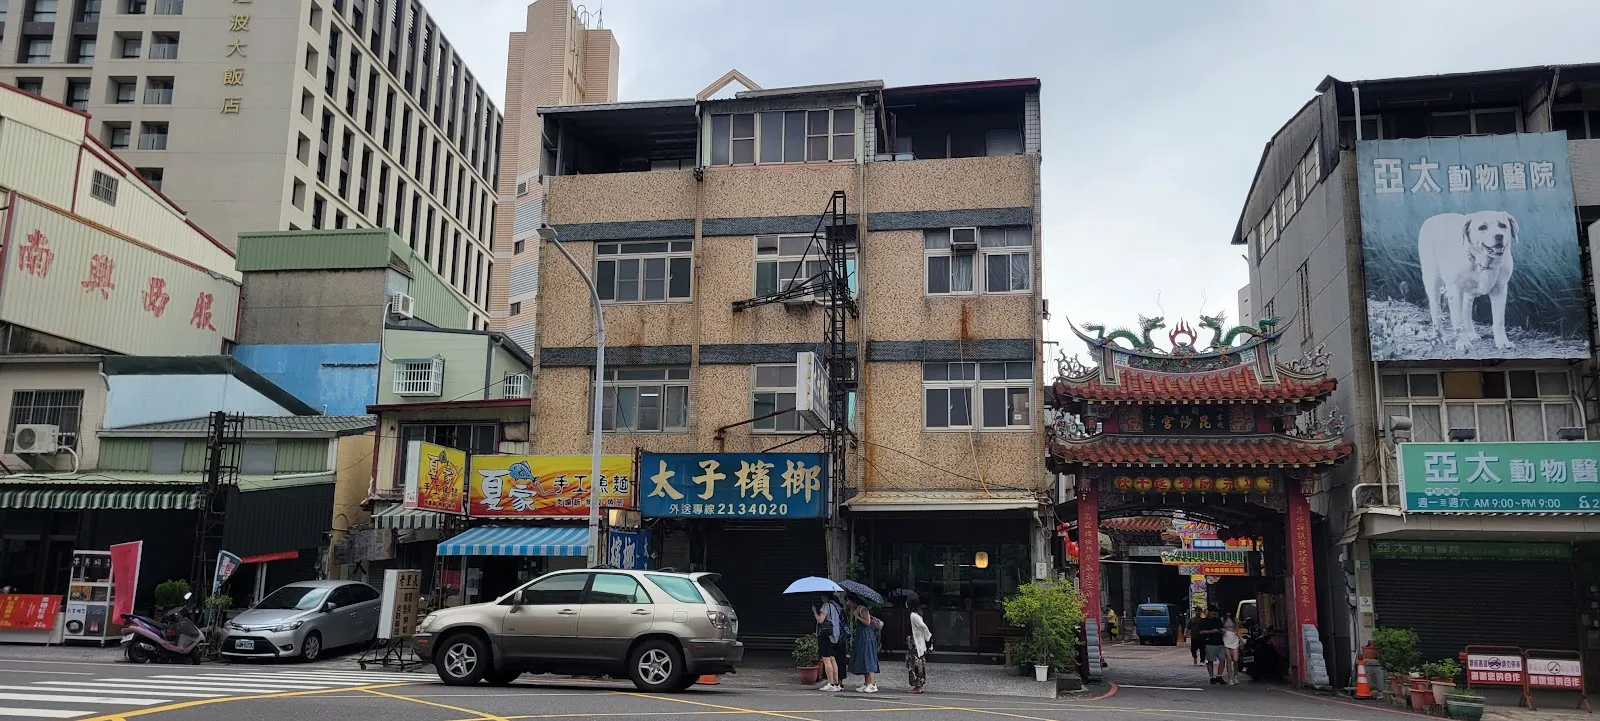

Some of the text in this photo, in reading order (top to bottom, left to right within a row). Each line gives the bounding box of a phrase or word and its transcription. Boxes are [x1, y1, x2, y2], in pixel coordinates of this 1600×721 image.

[220, 0, 252, 114] 波大飯店
[1373, 157, 1557, 195] 亞太動物醫院
[477, 468, 538, 512] 夏家
[647, 459, 822, 504] 太子檳榔
[1417, 497, 1470, 508] 週一至週六
[1474, 499, 1490, 508] AM
[1538, 498, 1561, 508] 9:00
